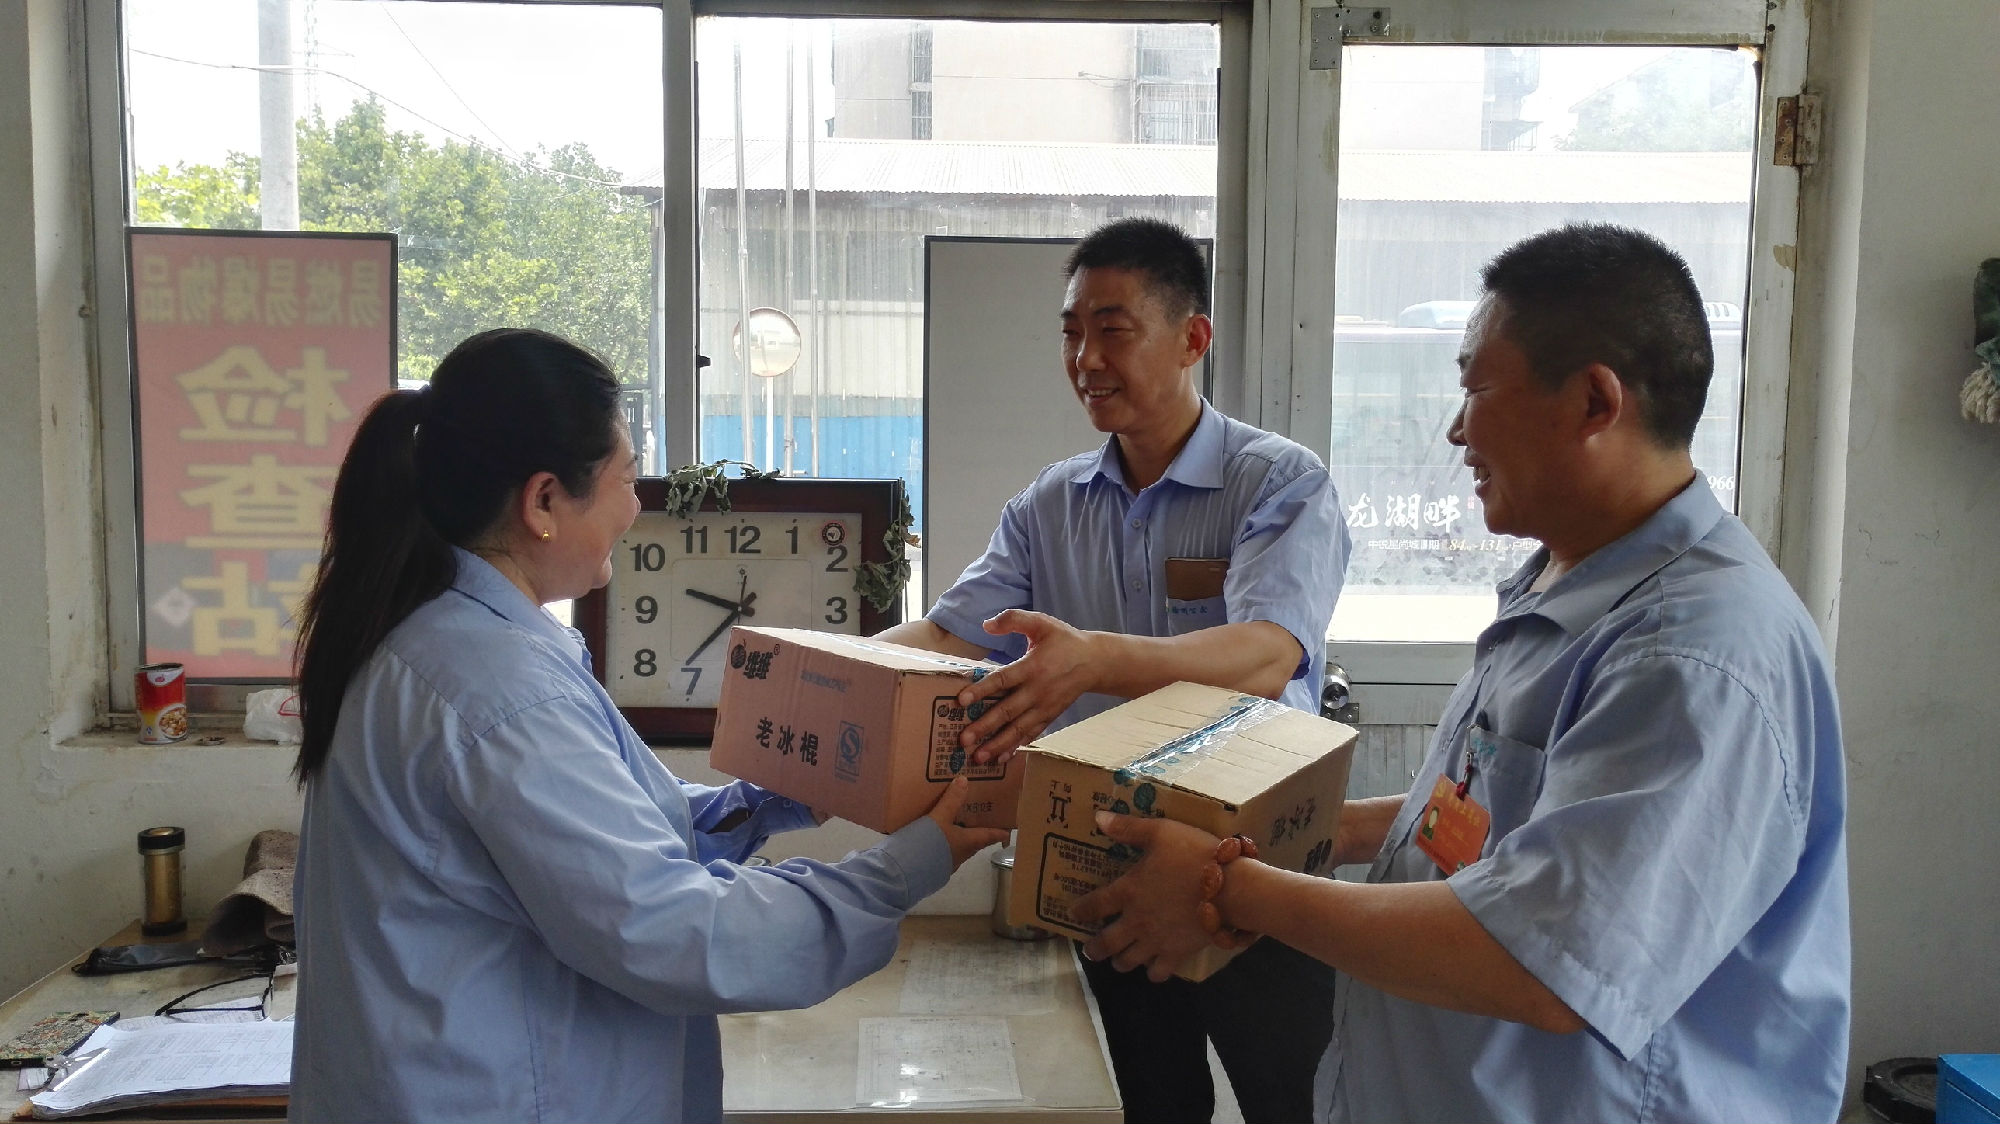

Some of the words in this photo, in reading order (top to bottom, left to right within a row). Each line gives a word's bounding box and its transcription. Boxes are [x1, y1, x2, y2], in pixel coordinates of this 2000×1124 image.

[1347, 493, 1461, 533] 龙湖畔
[681, 526, 708, 554] 11
[724, 526, 761, 554] 12
[785, 526, 799, 555] 1
[630, 544, 666, 572] 10
[825, 546, 849, 573] 2
[634, 596, 659, 624] 9
[825, 597, 848, 624] 3
[633, 649, 658, 677] 8
[681, 668, 702, 695] 7
[755, 716, 819, 766] 老冰棍
